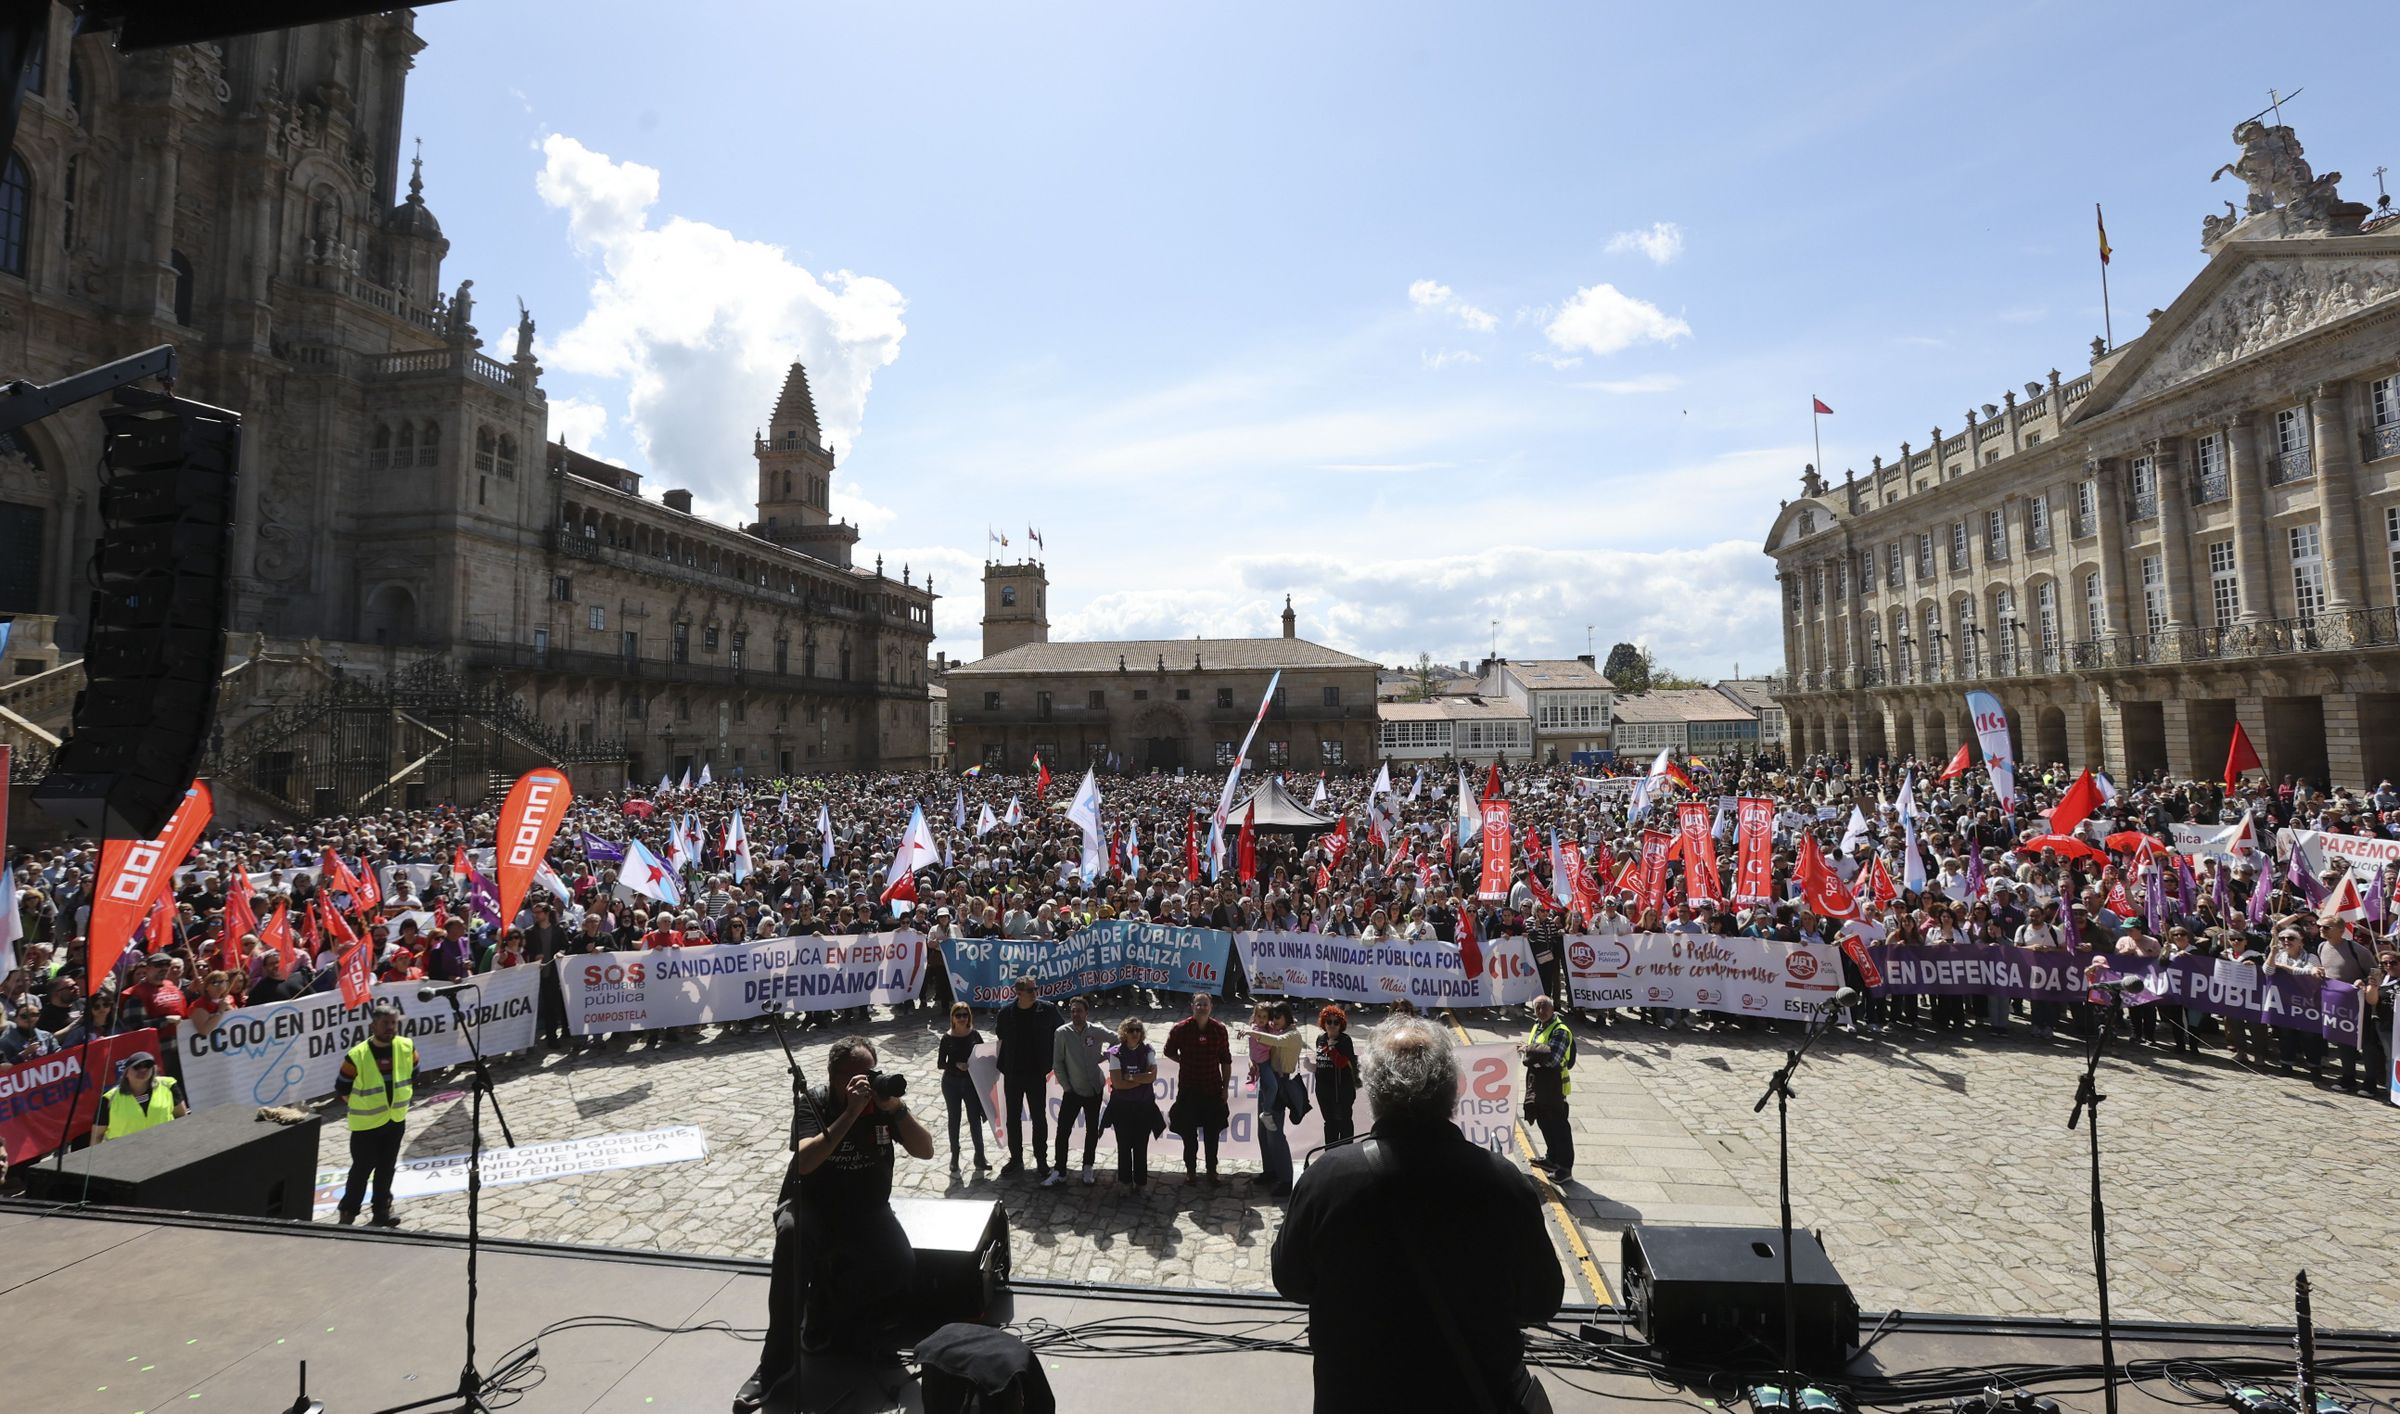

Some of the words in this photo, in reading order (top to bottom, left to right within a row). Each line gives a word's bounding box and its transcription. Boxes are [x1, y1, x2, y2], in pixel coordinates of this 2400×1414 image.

[1976, 711, 2007, 732] CIG
[509, 785, 552, 865] CCOO
[656, 954, 748, 980] SANIDADE
[752, 946, 822, 971] PÚBLICA
[826, 947, 847, 965] EN
[851, 943, 908, 963] PERIGO
[955, 941, 993, 961] POR
[1000, 943, 1048, 964] UNHA
[999, 963, 1020, 981] DE
[1100, 944, 1122, 964] EN
[1126, 943, 1182, 968] GALIZA
[1251, 941, 1276, 958] POR
[1278, 942, 1311, 960] UNHA
[1315, 943, 1374, 966] SANIDADE
[1377, 945, 1432, 969] PÚBLICA
[1435, 951, 1462, 970] FOR
[1571, 946, 1591, 957] UGT
[1673, 943, 1681, 958] O
[1790, 955, 1814, 968] UGT
[584, 962, 646, 986] SOS
[1187, 960, 1217, 981] CIG
[1689, 962, 1780, 984] compromiso
[1888, 960, 1917, 985] EN
[1922, 960, 2024, 988] DEFENSA
[2029, 966, 2062, 991] DA
[1285, 968, 1308, 985] Máis
[1312, 970, 1368, 993] PERSOAL
[1380, 975, 1407, 993] Máis
[1411, 979, 1480, 997] CALIDADE
[584, 990, 645, 1008] pública
[1574, 988, 1633, 1001] ESENCIAIS
[583, 1009, 647, 1024] COMPOSTELA
[190, 1022, 265, 1058] CCOO
[274, 1011, 304, 1039] EN
[309, 1034, 335, 1058] DA
[340, 1014, 446, 1050] SAADE
[517, 1143, 578, 1157] QUEN
[425, 1170, 442, 1181] A
[450, 1154, 565, 1177] SNIDADE
